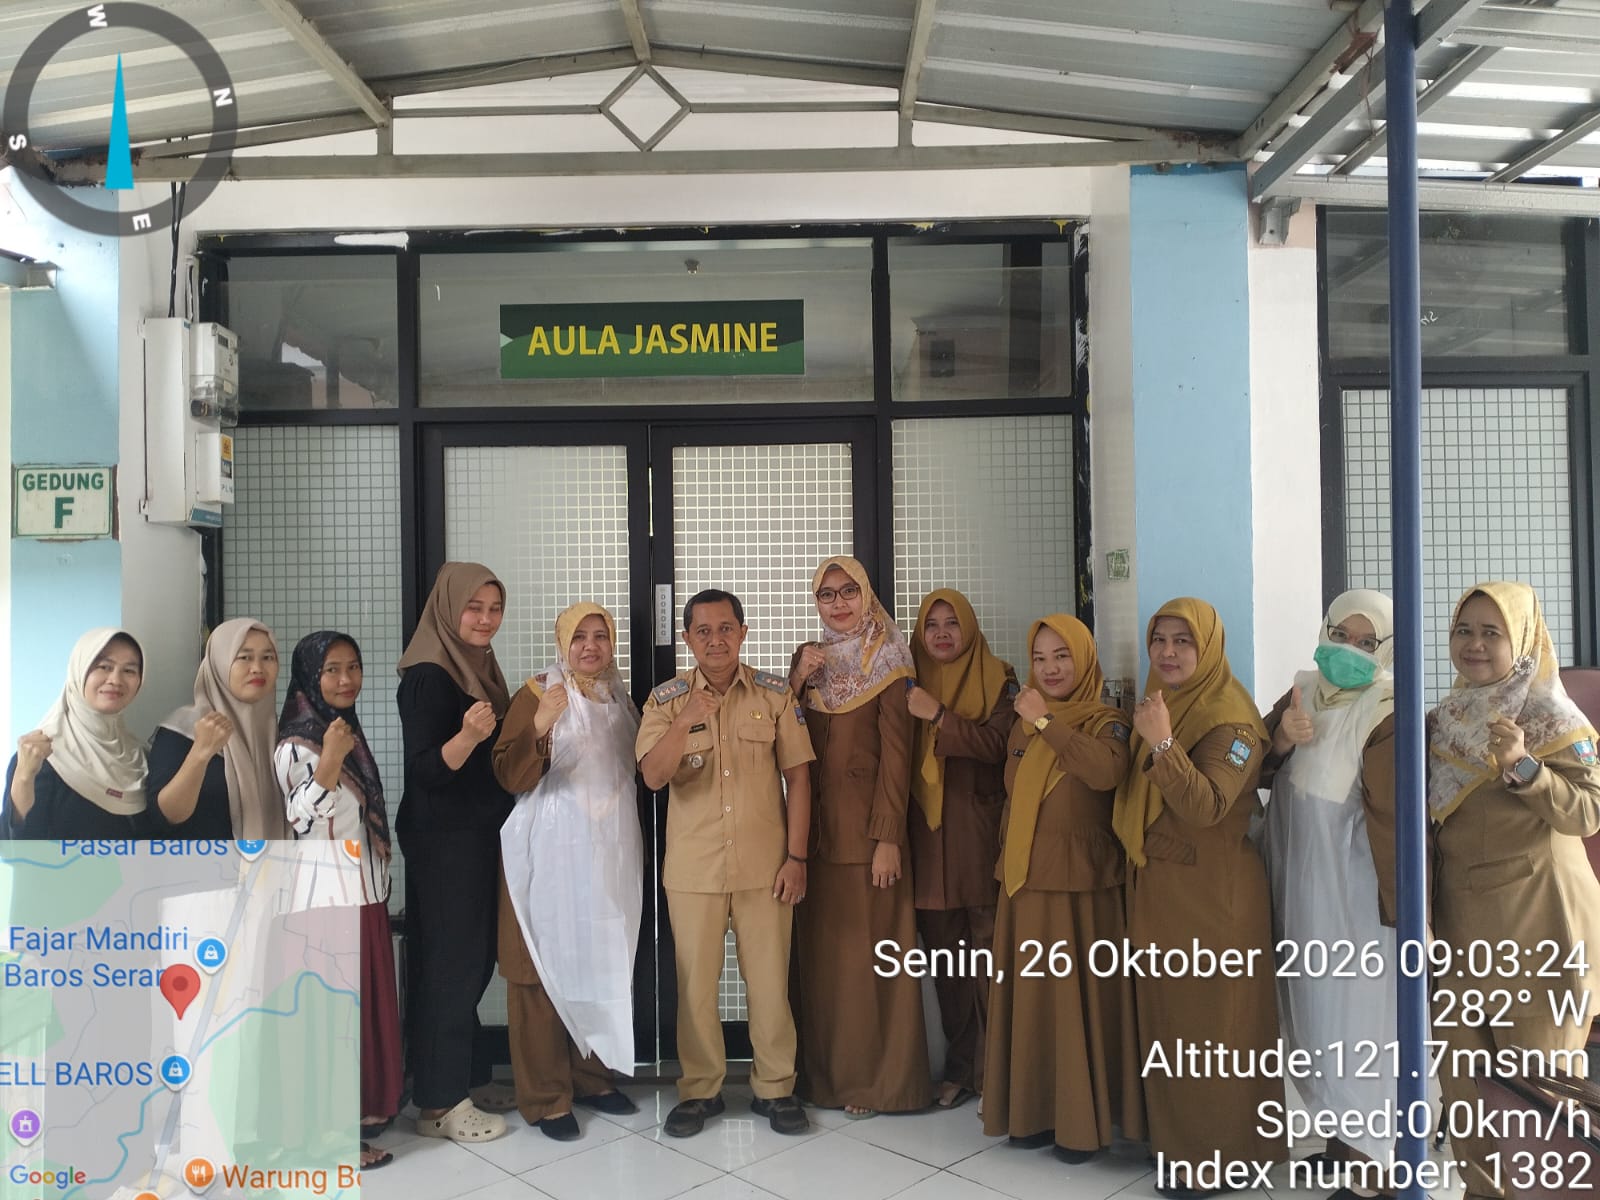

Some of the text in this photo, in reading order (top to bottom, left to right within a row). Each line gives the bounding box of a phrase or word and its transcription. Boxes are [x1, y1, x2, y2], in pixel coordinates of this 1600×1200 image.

[528, 321, 778, 356] AULA JASMINE
[22, 472, 104, 491] GEDUNG
[54, 496, 75, 528] F
